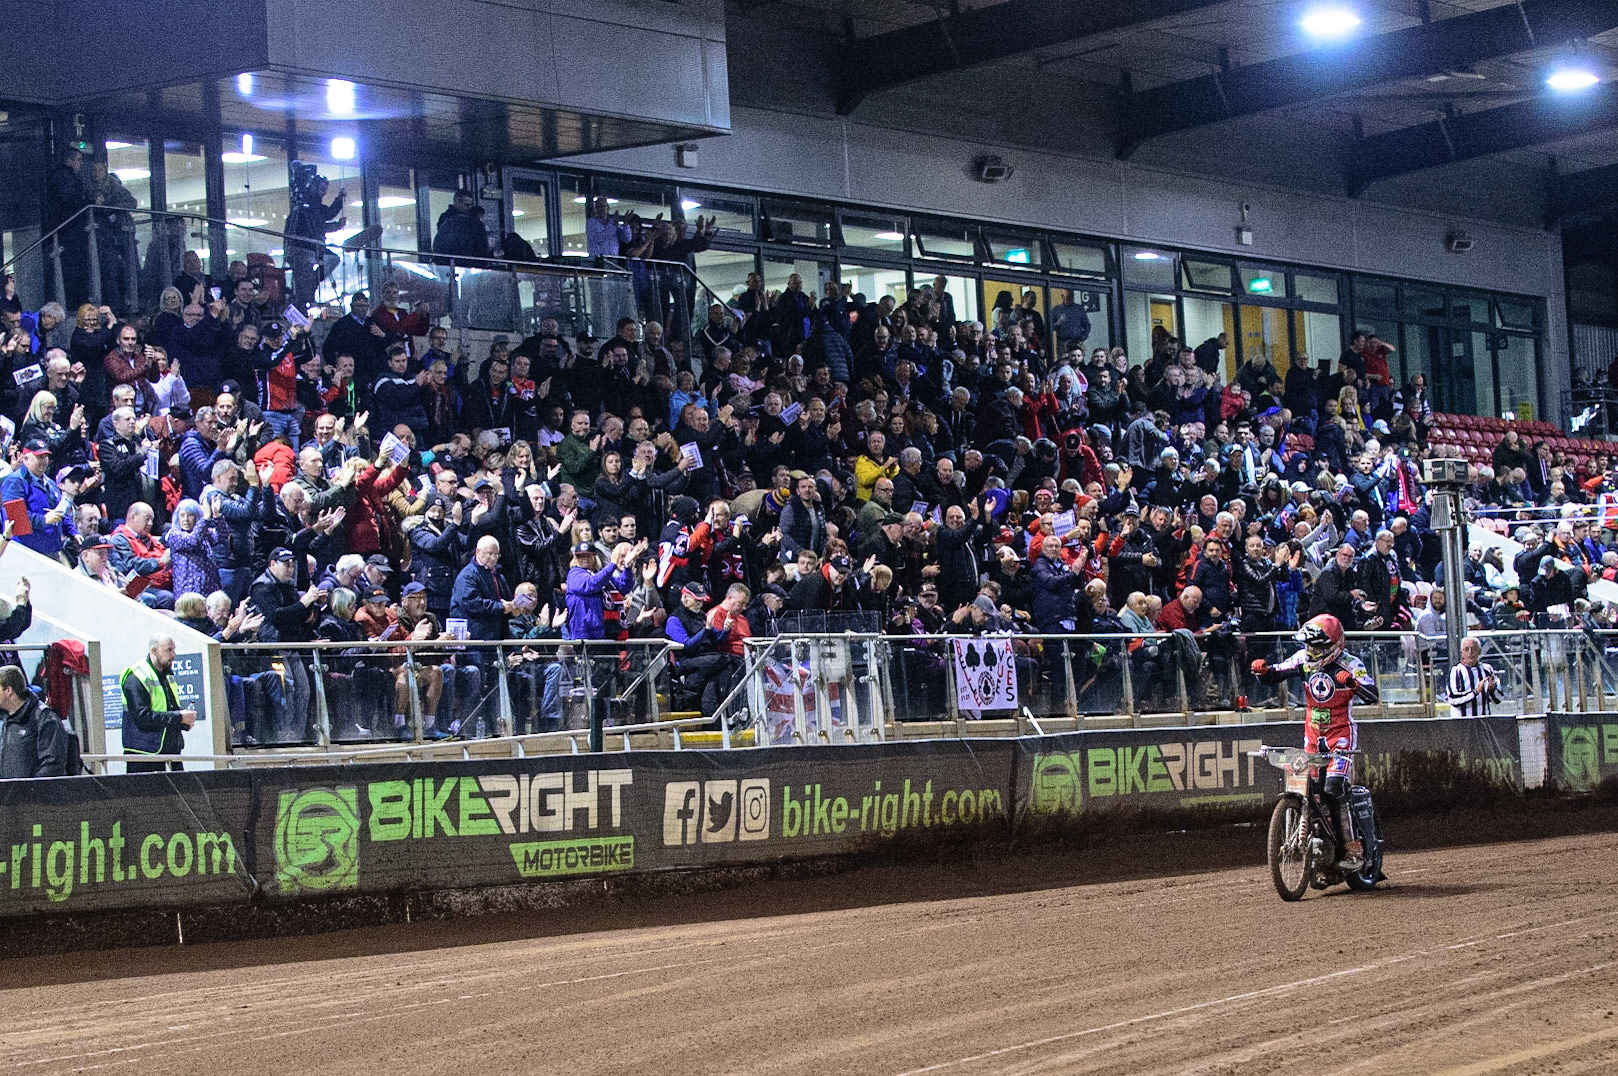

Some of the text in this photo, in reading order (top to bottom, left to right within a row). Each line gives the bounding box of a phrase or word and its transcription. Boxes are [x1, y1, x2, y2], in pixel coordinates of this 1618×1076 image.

[1005, 641, 1015, 702] ACES
[1087, 739, 1263, 797] BIKERIGHT
[368, 768, 633, 842] BIKERIGHT
[782, 778, 1002, 838] bike-right.com
[523, 843, 632, 872] MOTORBIKE
